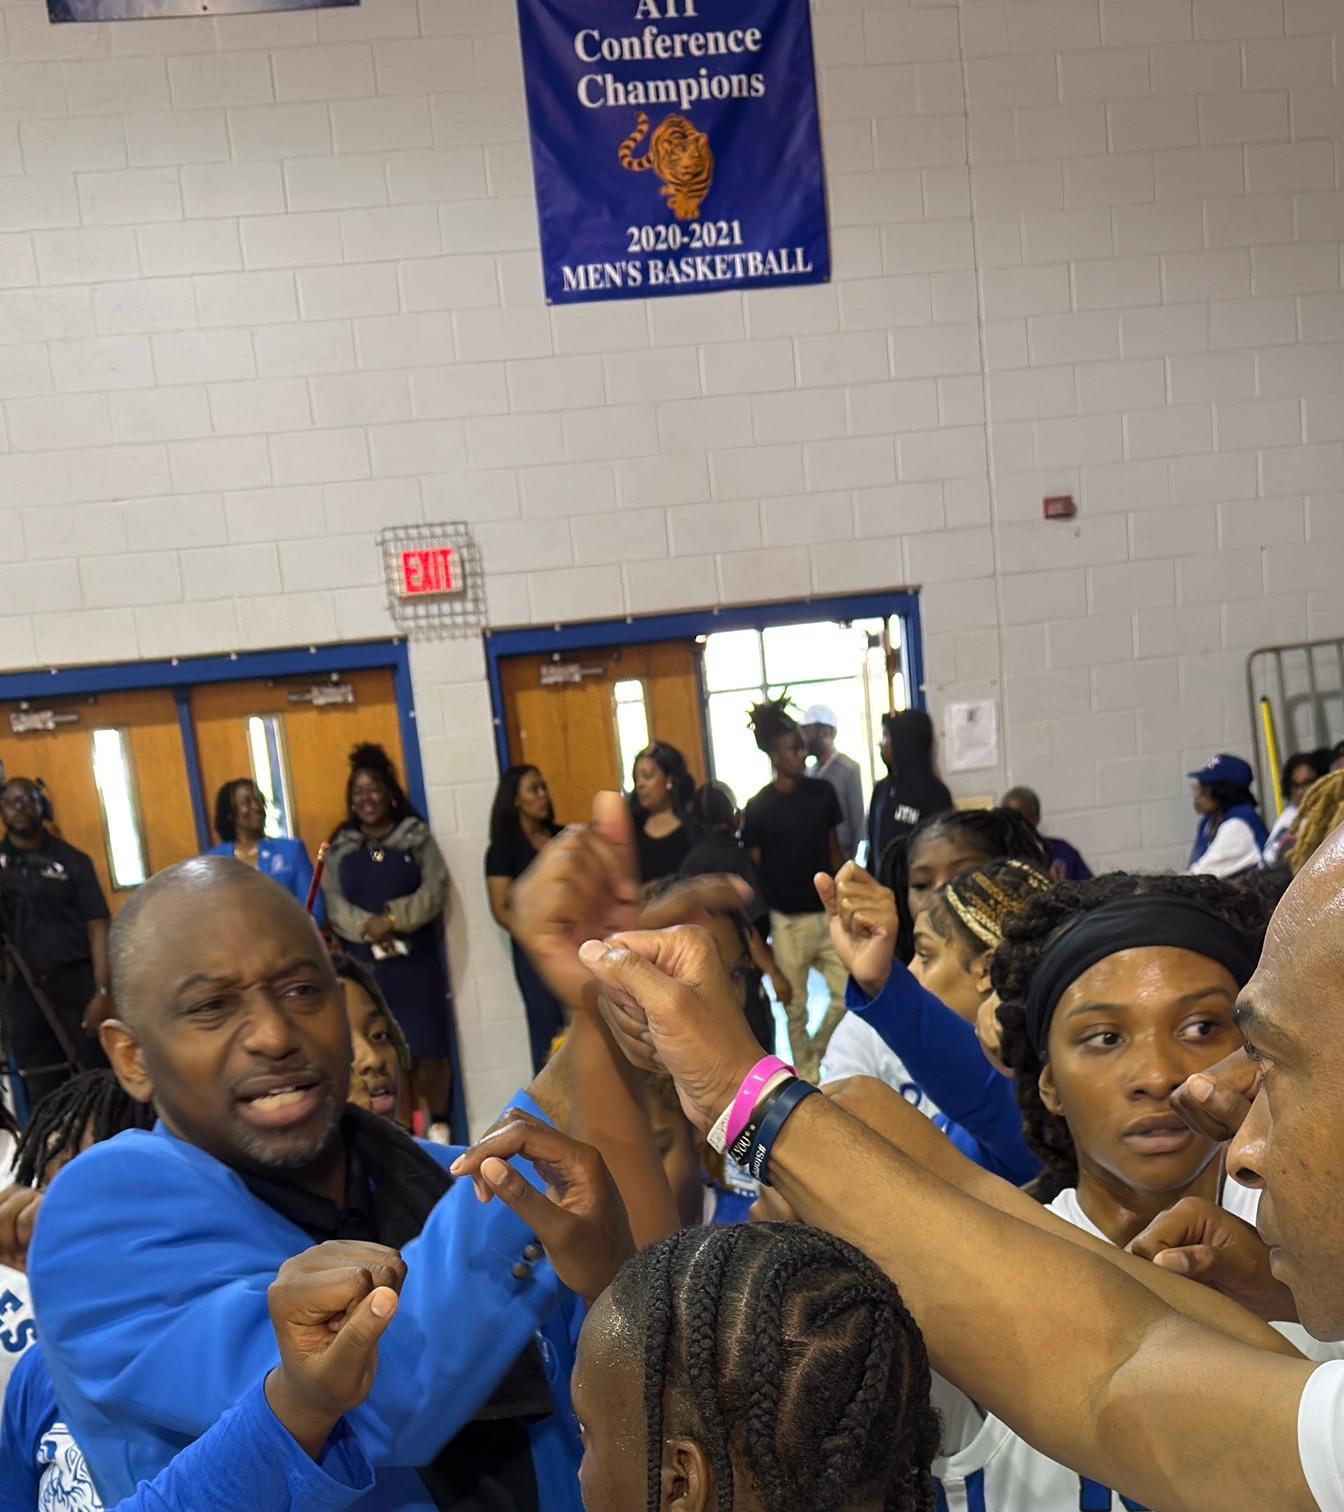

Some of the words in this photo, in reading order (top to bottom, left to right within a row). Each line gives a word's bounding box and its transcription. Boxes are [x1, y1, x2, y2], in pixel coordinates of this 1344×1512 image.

[574, 26, 763, 62] Conference
[577, 68, 765, 110] Champions
[626, 220, 744, 252] 2020-2021
[562, 260, 642, 291] MEN'S
[648, 248, 813, 285] BASKETBALL
[402, 548, 452, 593] EXIT
